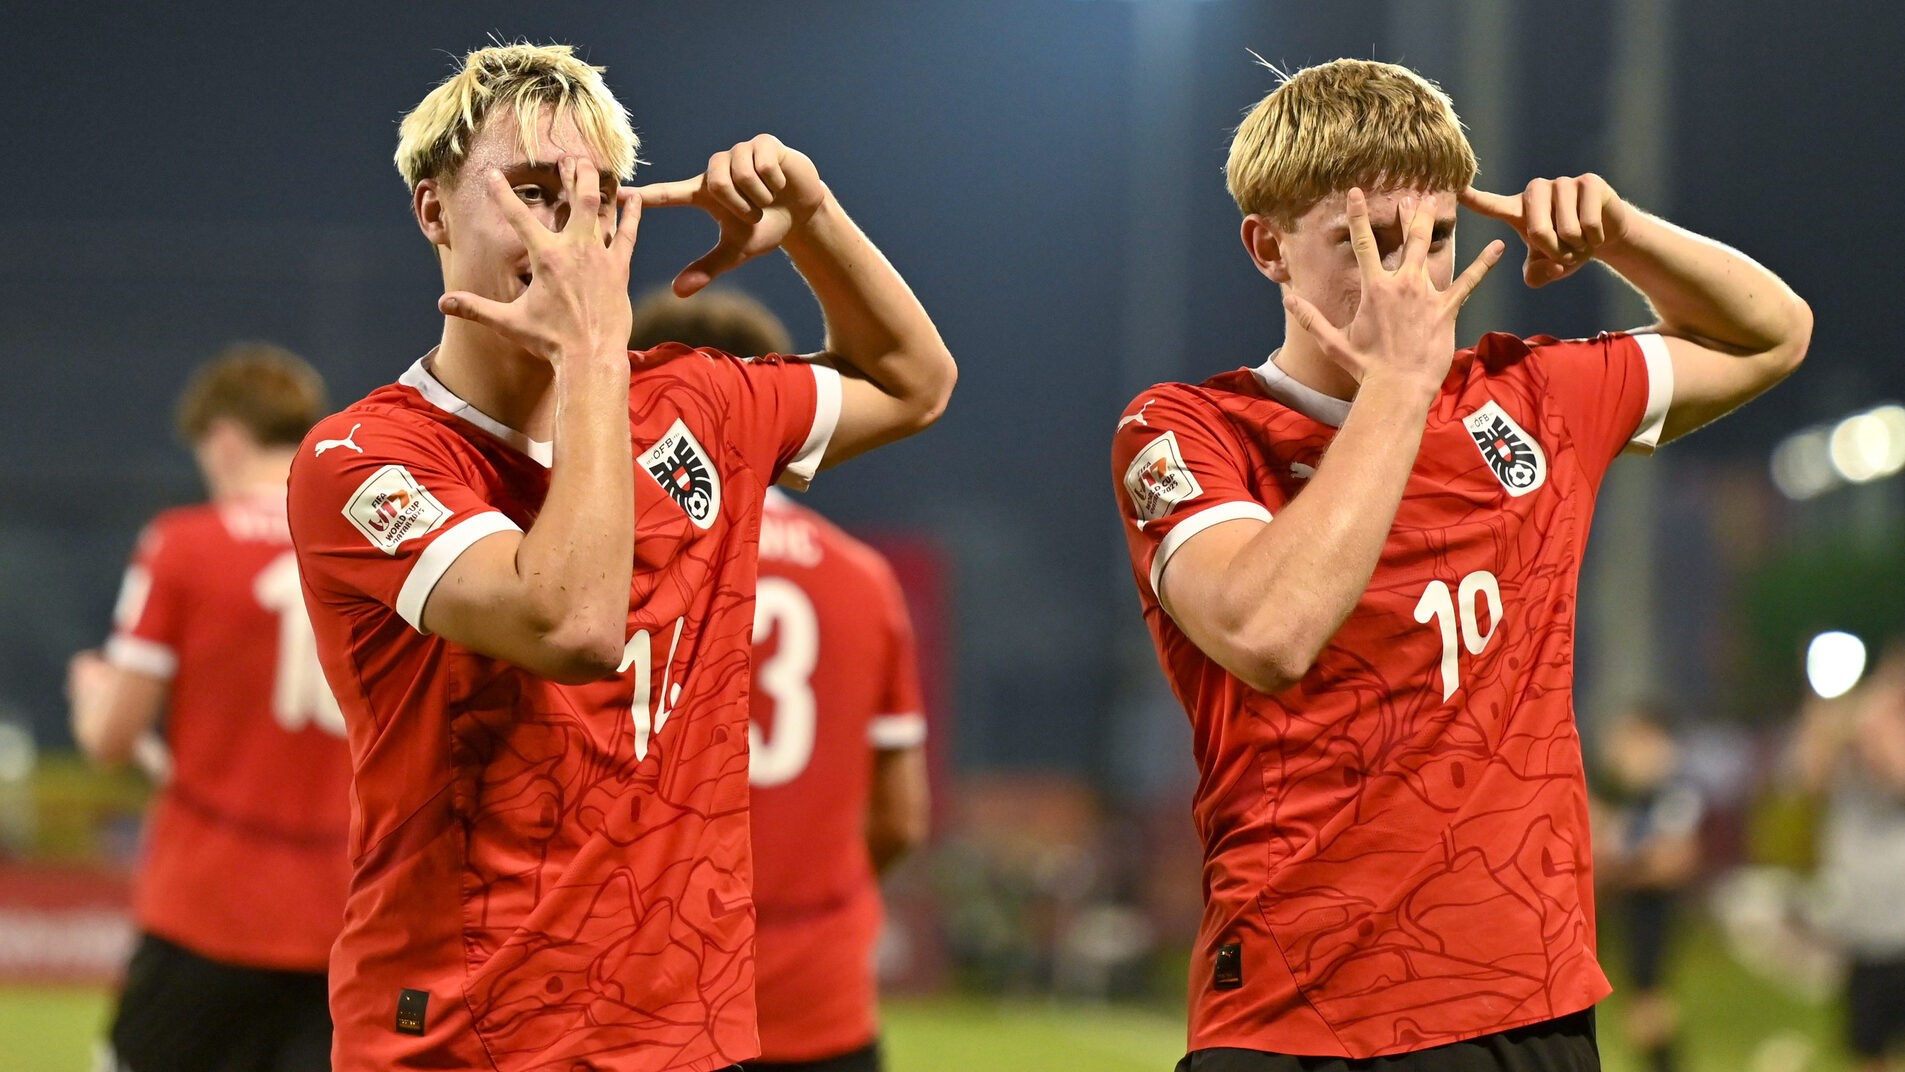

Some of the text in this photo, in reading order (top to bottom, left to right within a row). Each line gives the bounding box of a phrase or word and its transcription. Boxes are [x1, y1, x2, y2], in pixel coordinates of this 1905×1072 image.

[652, 437, 674, 460] ÖFB
[371, 492, 387, 509] FIFA
[385, 500, 420, 541] WORLD CUP
[1414, 570, 1504, 704] 10
